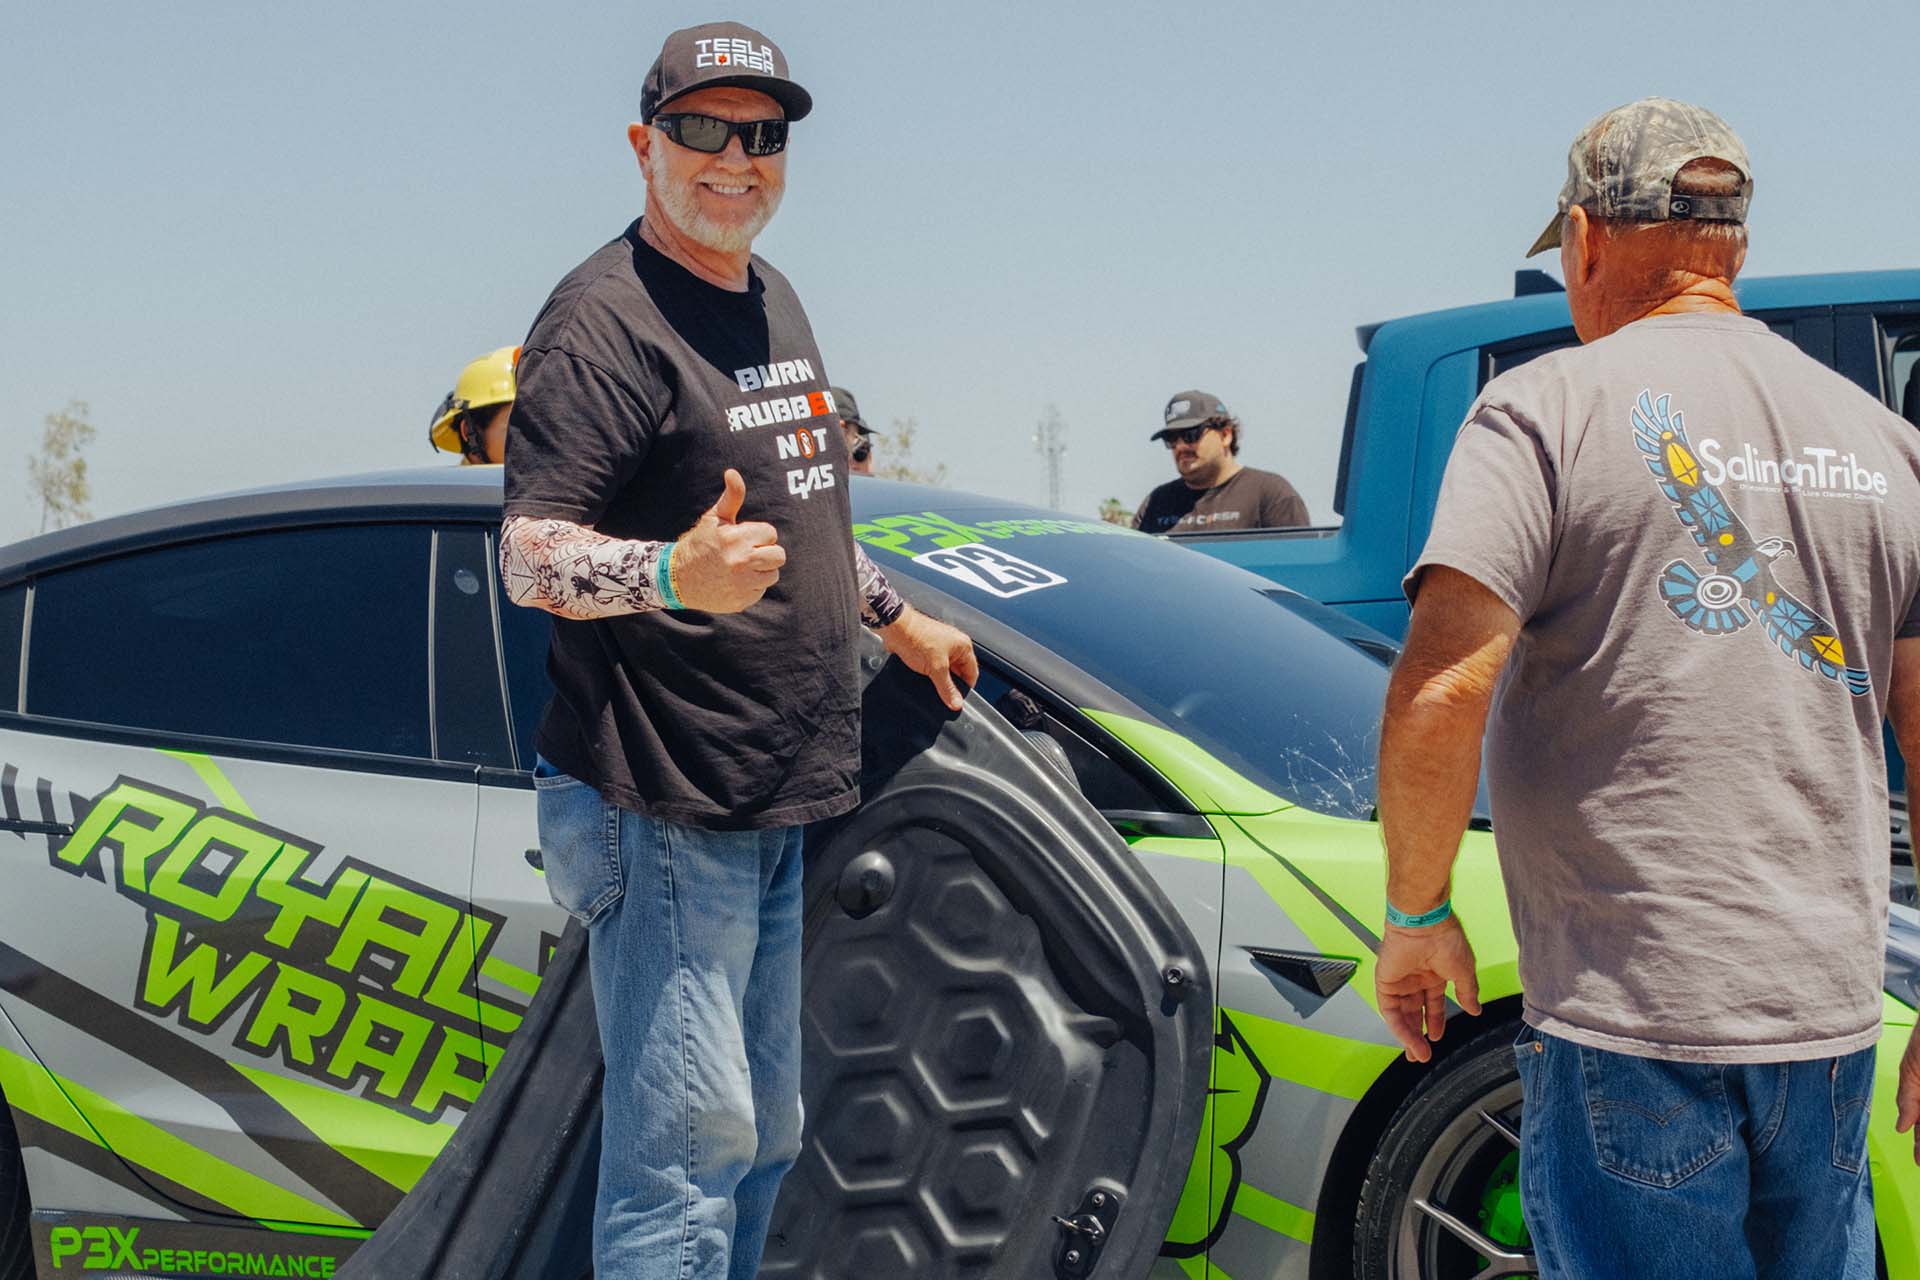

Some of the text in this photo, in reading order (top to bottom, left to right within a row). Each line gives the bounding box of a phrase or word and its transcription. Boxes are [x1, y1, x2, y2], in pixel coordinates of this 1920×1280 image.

[696, 38, 773, 62] TESLA
[696, 53, 775, 76] CORSA
[735, 359, 816, 392] BURN
[725, 391, 838, 432] RUBBER
[776, 428, 827, 460] NOT
[787, 464, 835, 499] GAS
[928, 546, 1054, 592] 23
[57, 782, 523, 1034] ROYAL
[143, 913, 507, 1113] WRAP
[51, 1226, 337, 1279] P3X PERFORMANCE
